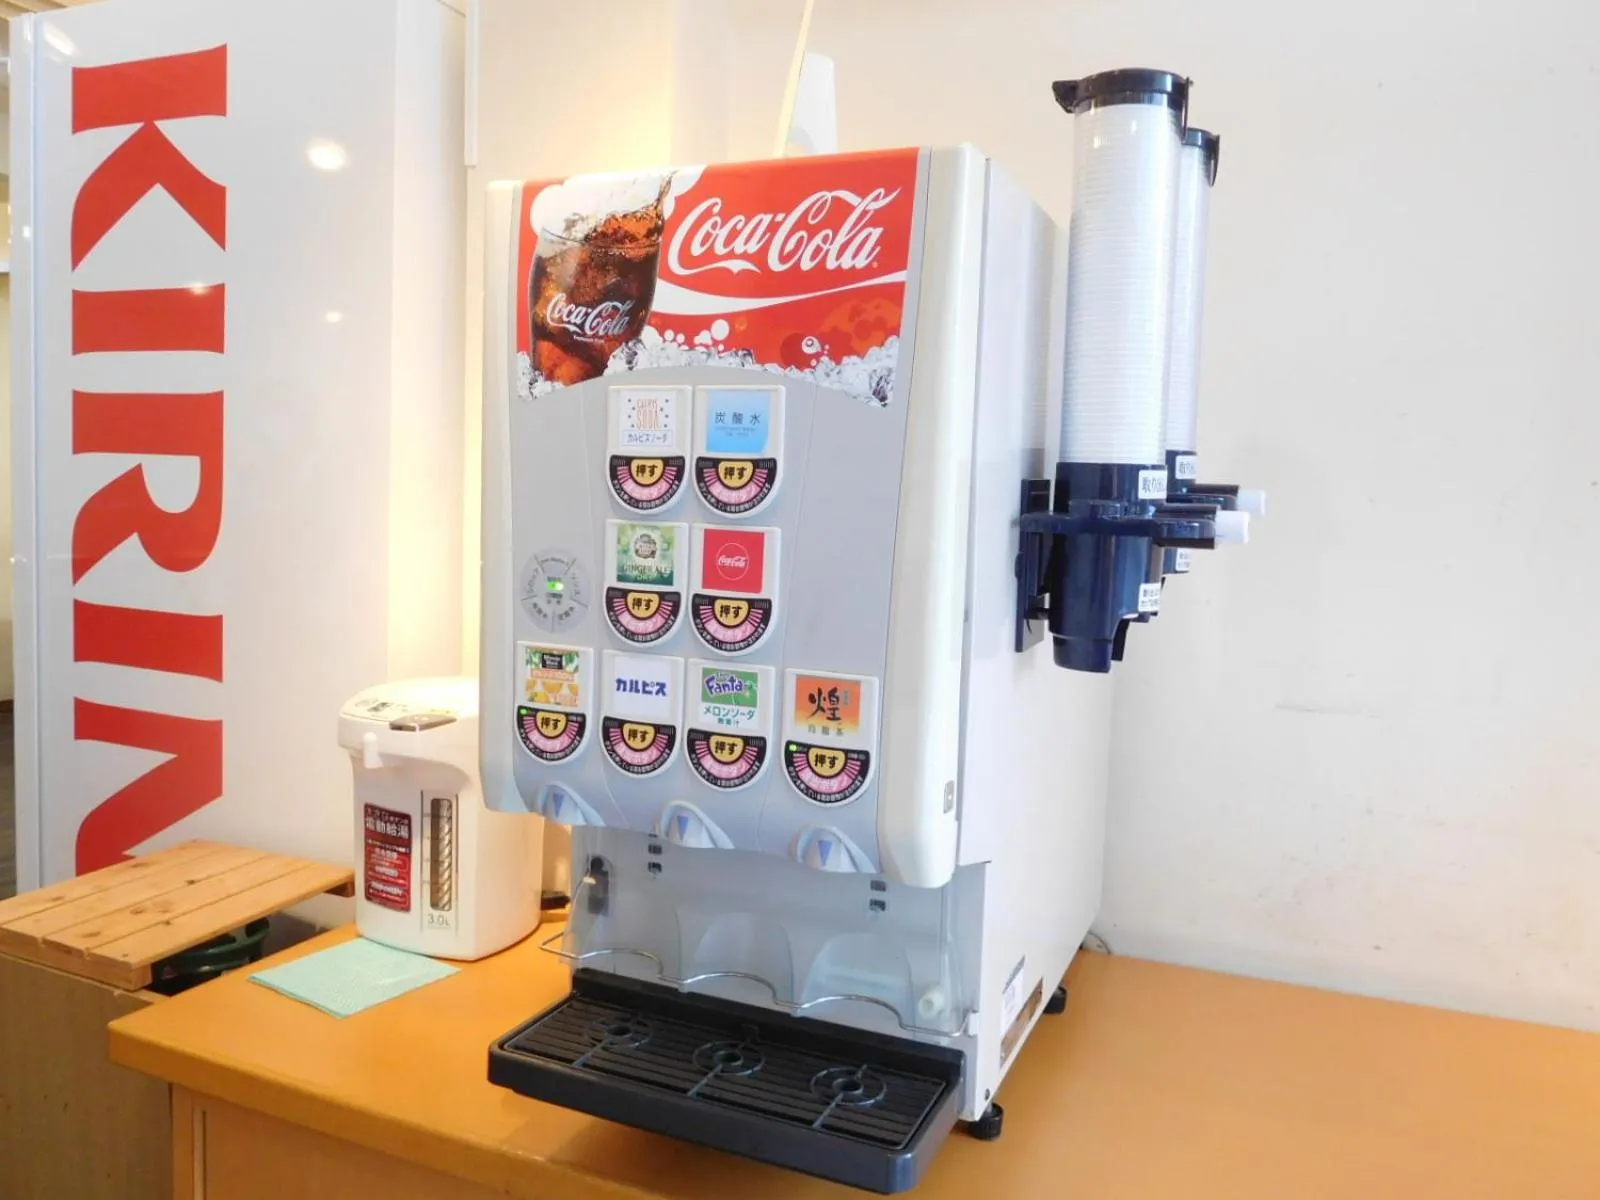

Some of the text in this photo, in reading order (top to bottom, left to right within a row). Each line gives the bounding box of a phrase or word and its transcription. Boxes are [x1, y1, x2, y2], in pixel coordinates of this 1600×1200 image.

[667, 187, 902, 275] Coca-Cola
[546, 292, 636, 336] Coca-Cola
[714, 410, 761, 426] 炭酸水
[71, 43, 228, 878] KIRIN
[636, 463, 658, 478] 押す
[724, 466, 748, 480] 押す
[632, 597, 654, 611] 押す
[719, 605, 743, 619] 押す
[615, 678, 667, 697] カルピス
[705, 675, 744, 696] Fanta
[703, 706, 756, 721] メロンソーダ
[540, 716, 562, 731] 押す
[627, 728, 651, 743] 押す
[714, 740, 738, 755] 押す
[814, 754, 839, 769] 押す
